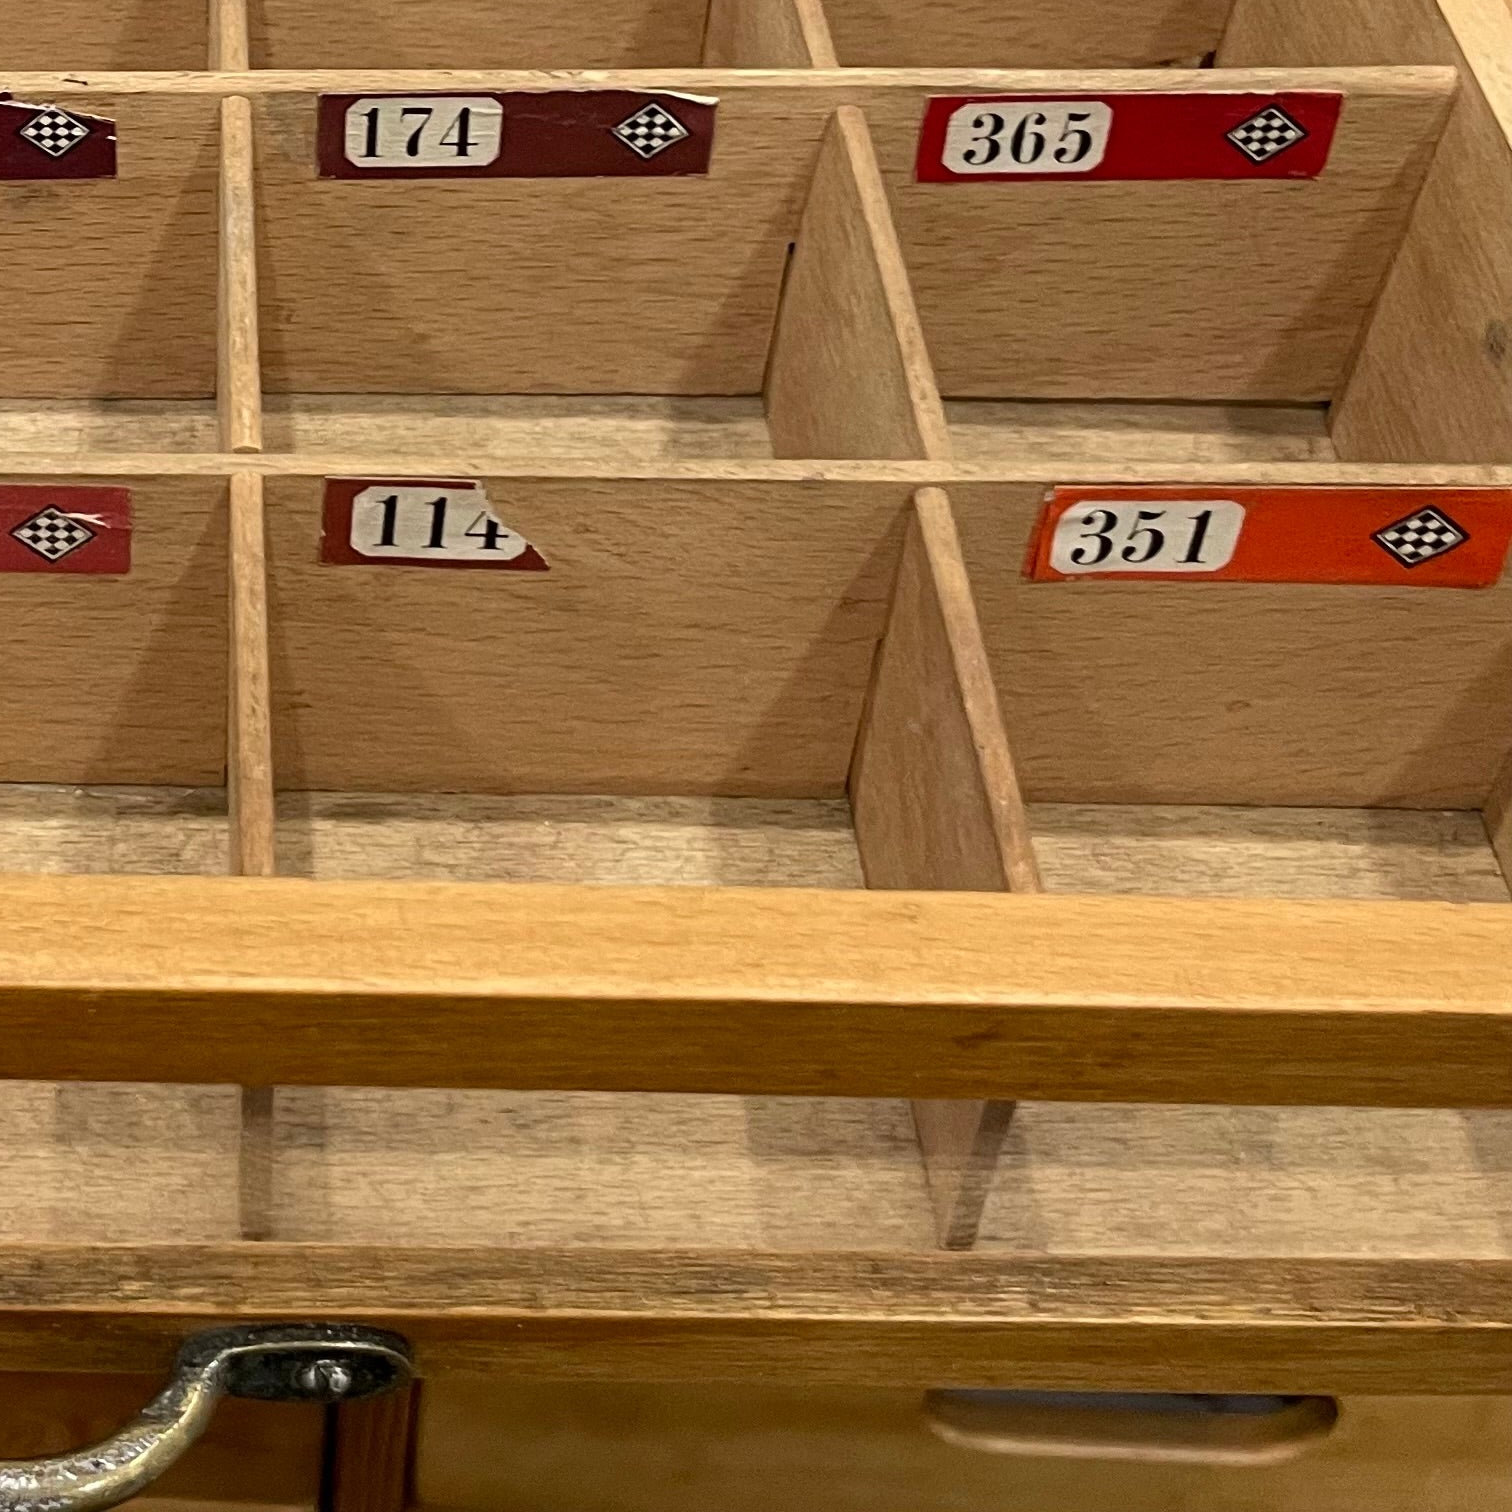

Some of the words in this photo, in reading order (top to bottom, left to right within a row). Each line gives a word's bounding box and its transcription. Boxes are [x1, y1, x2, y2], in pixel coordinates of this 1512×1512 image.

[359, 107, 479, 158] 174
[962, 112, 1093, 166] 365
[373, 494, 510, 551] 114
[1070, 509, 1213, 566] 351
